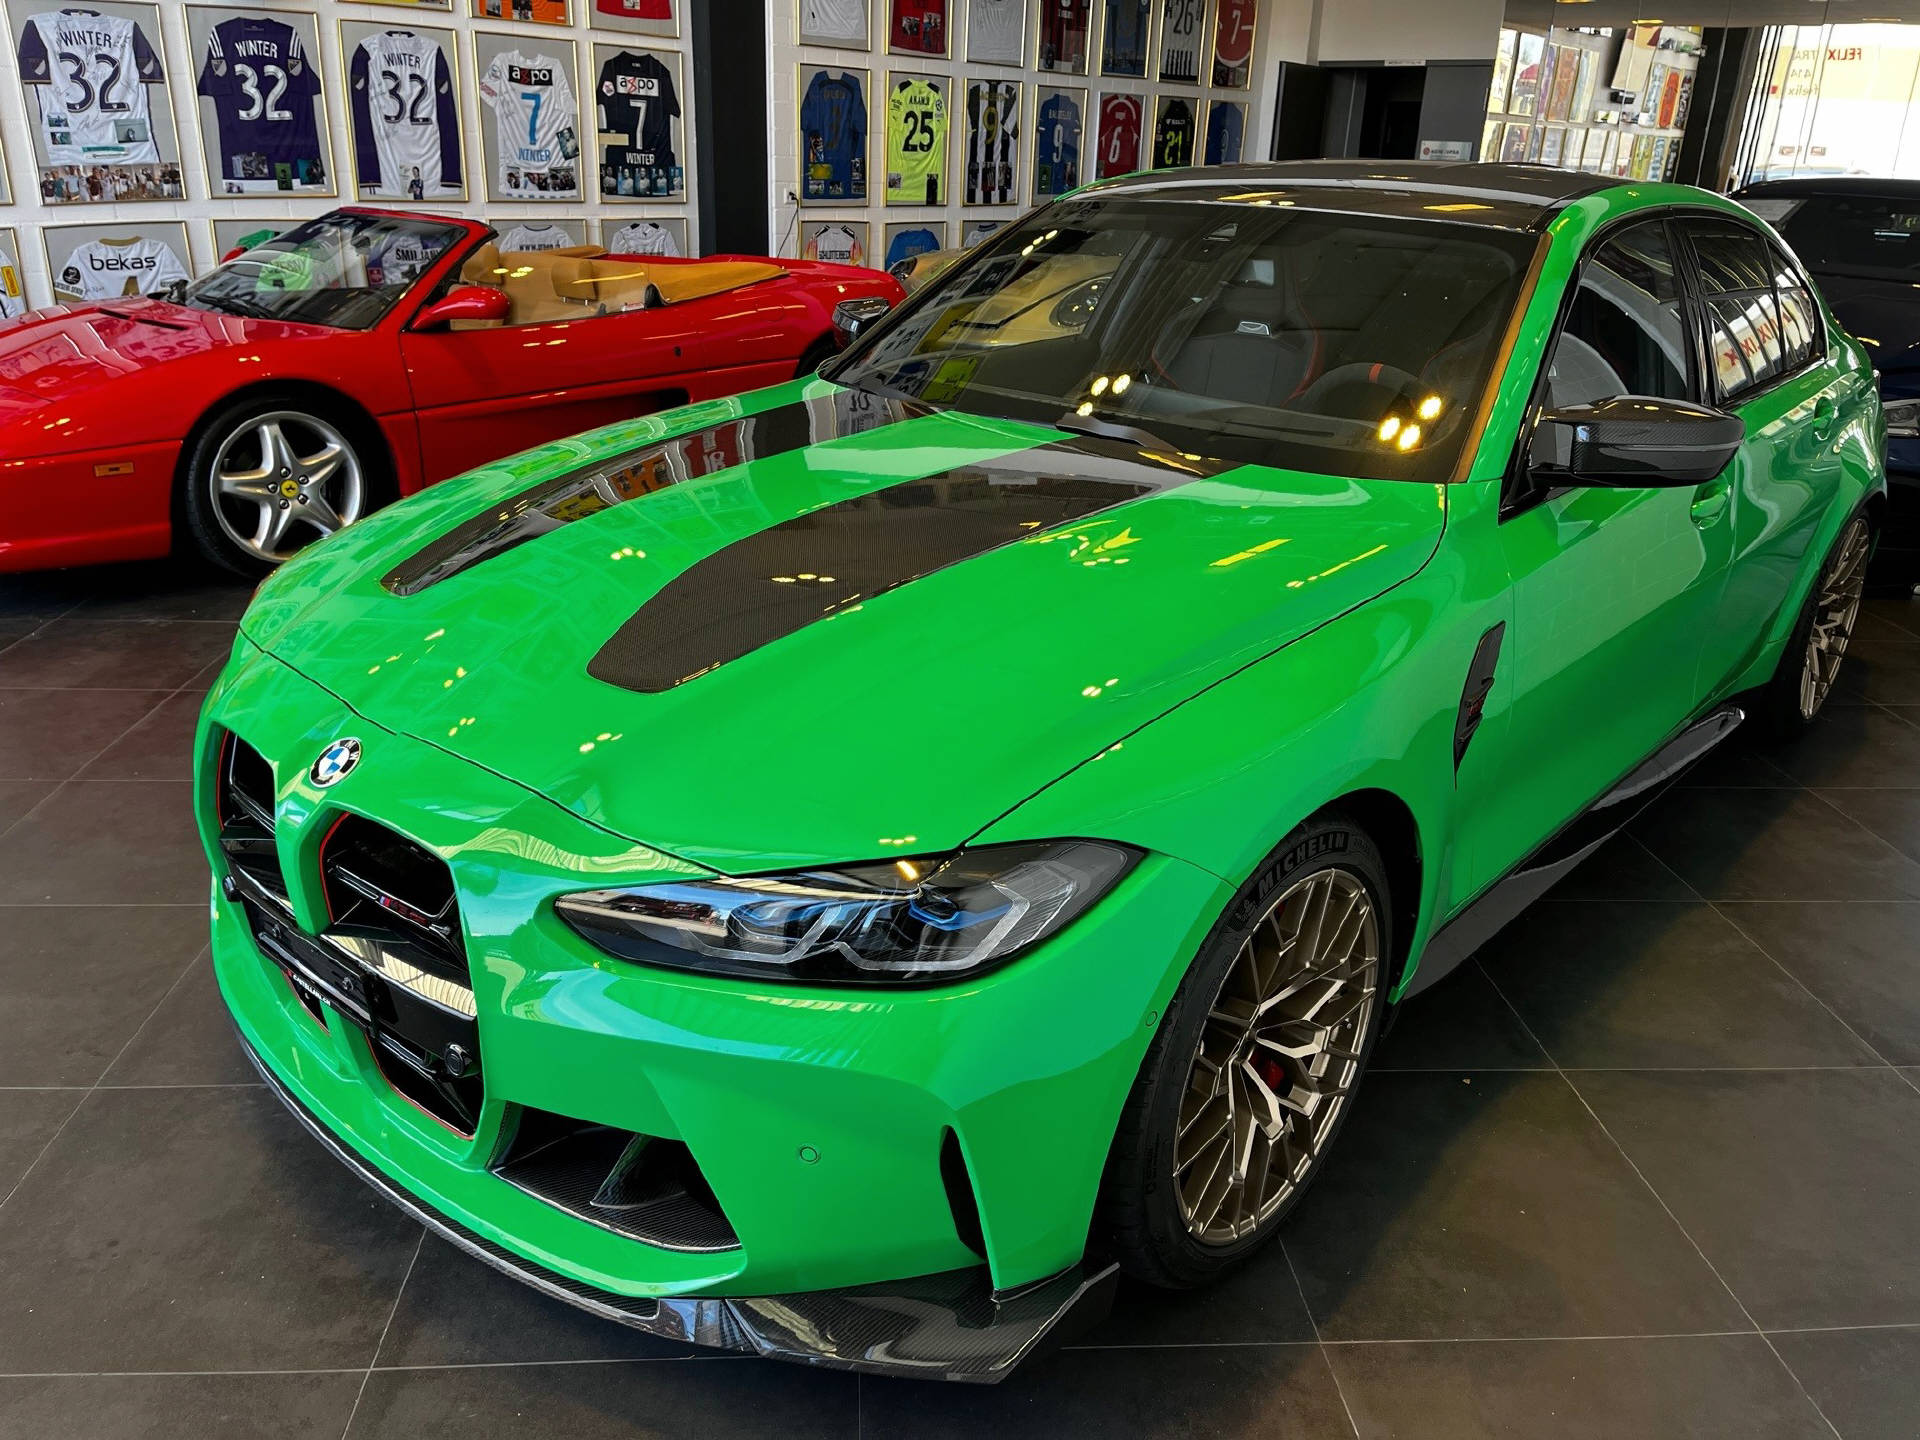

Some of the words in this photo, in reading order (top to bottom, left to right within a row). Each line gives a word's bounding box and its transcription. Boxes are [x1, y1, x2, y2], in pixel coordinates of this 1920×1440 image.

[59, 30, 112, 48] WINTER
[1230, 9, 1241, 44] 7
[235, 40, 278, 58] WINTER
[383, 53, 421, 68] WINTER
[58, 52, 131, 113] 32
[234, 63, 293, 121] 32
[381, 70, 433, 126] 32
[521, 92, 541, 146] 7
[629, 99, 647, 150] 7
[902, 110, 934, 152] 25
[983, 106, 998, 144] 9
[518, 148, 551, 161] WINTER
[626, 152, 655, 165] WINTER
[1052, 123, 1063, 163] 9
[1108, 126, 1122, 163] 6
[1164, 130, 1182, 165] 21
[89, 253, 156, 271] bekaş
[1258, 832, 1346, 899] MICHELIN
